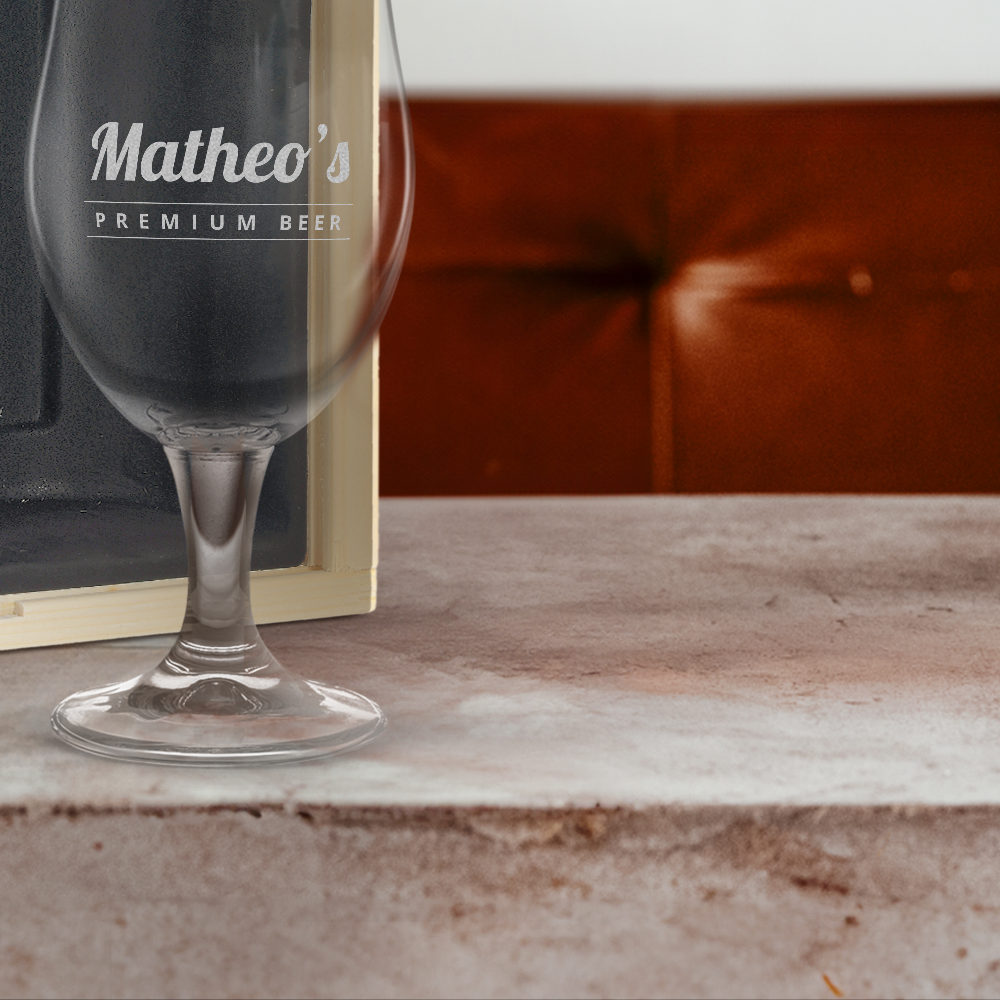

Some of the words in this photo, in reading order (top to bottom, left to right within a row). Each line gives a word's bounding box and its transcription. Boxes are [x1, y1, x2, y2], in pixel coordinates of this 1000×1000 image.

[91, 121, 350, 184] Matheo's
[95, 212, 256, 231] PREMIUM
[279, 214, 341, 231] BEER
